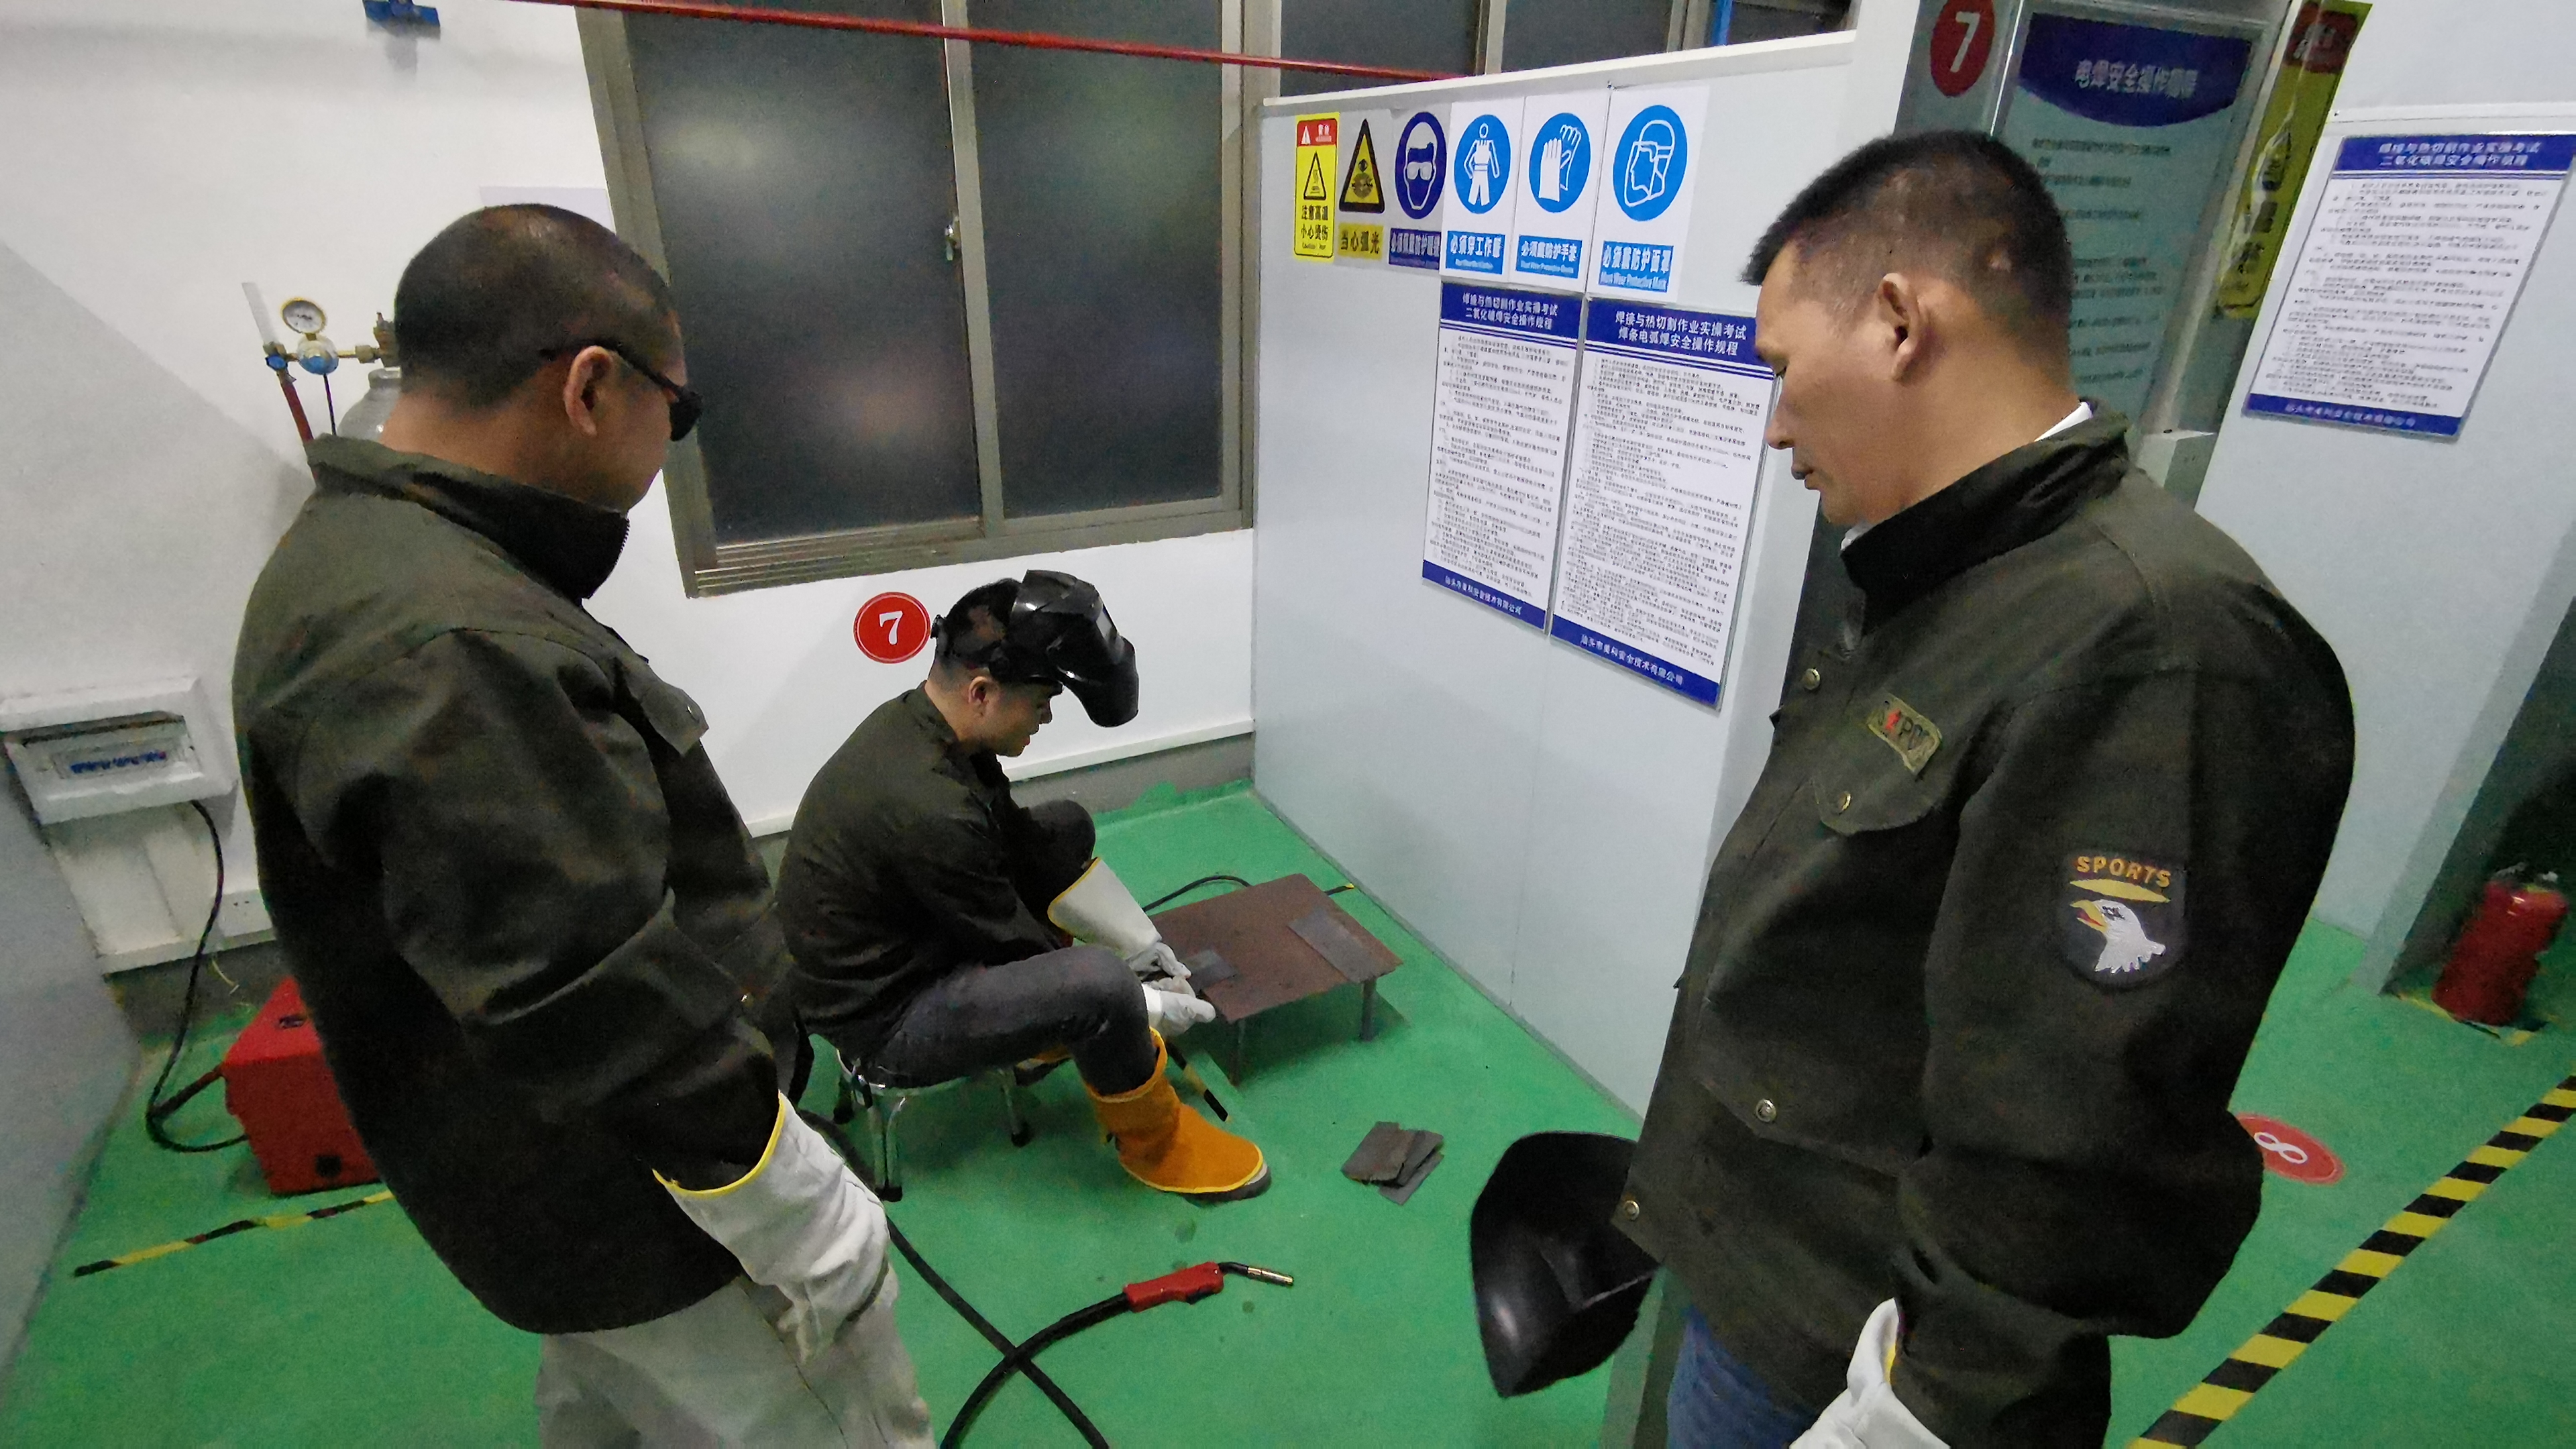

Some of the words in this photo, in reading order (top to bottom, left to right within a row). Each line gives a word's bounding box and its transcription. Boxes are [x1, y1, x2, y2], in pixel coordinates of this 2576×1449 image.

[1955, 11, 1980, 72] 7
[1340, 230, 1380, 254] 当心弧光
[1615, 311, 1747, 340] 焊接与热切割作业实操考试
[1618, 326, 1739, 356] 焊条电弧焊安全操作规程
[879, 610, 903, 645] 7
[2076, 856, 2171, 887] SPORTS
[2254, 1132, 2308, 1164] 8
